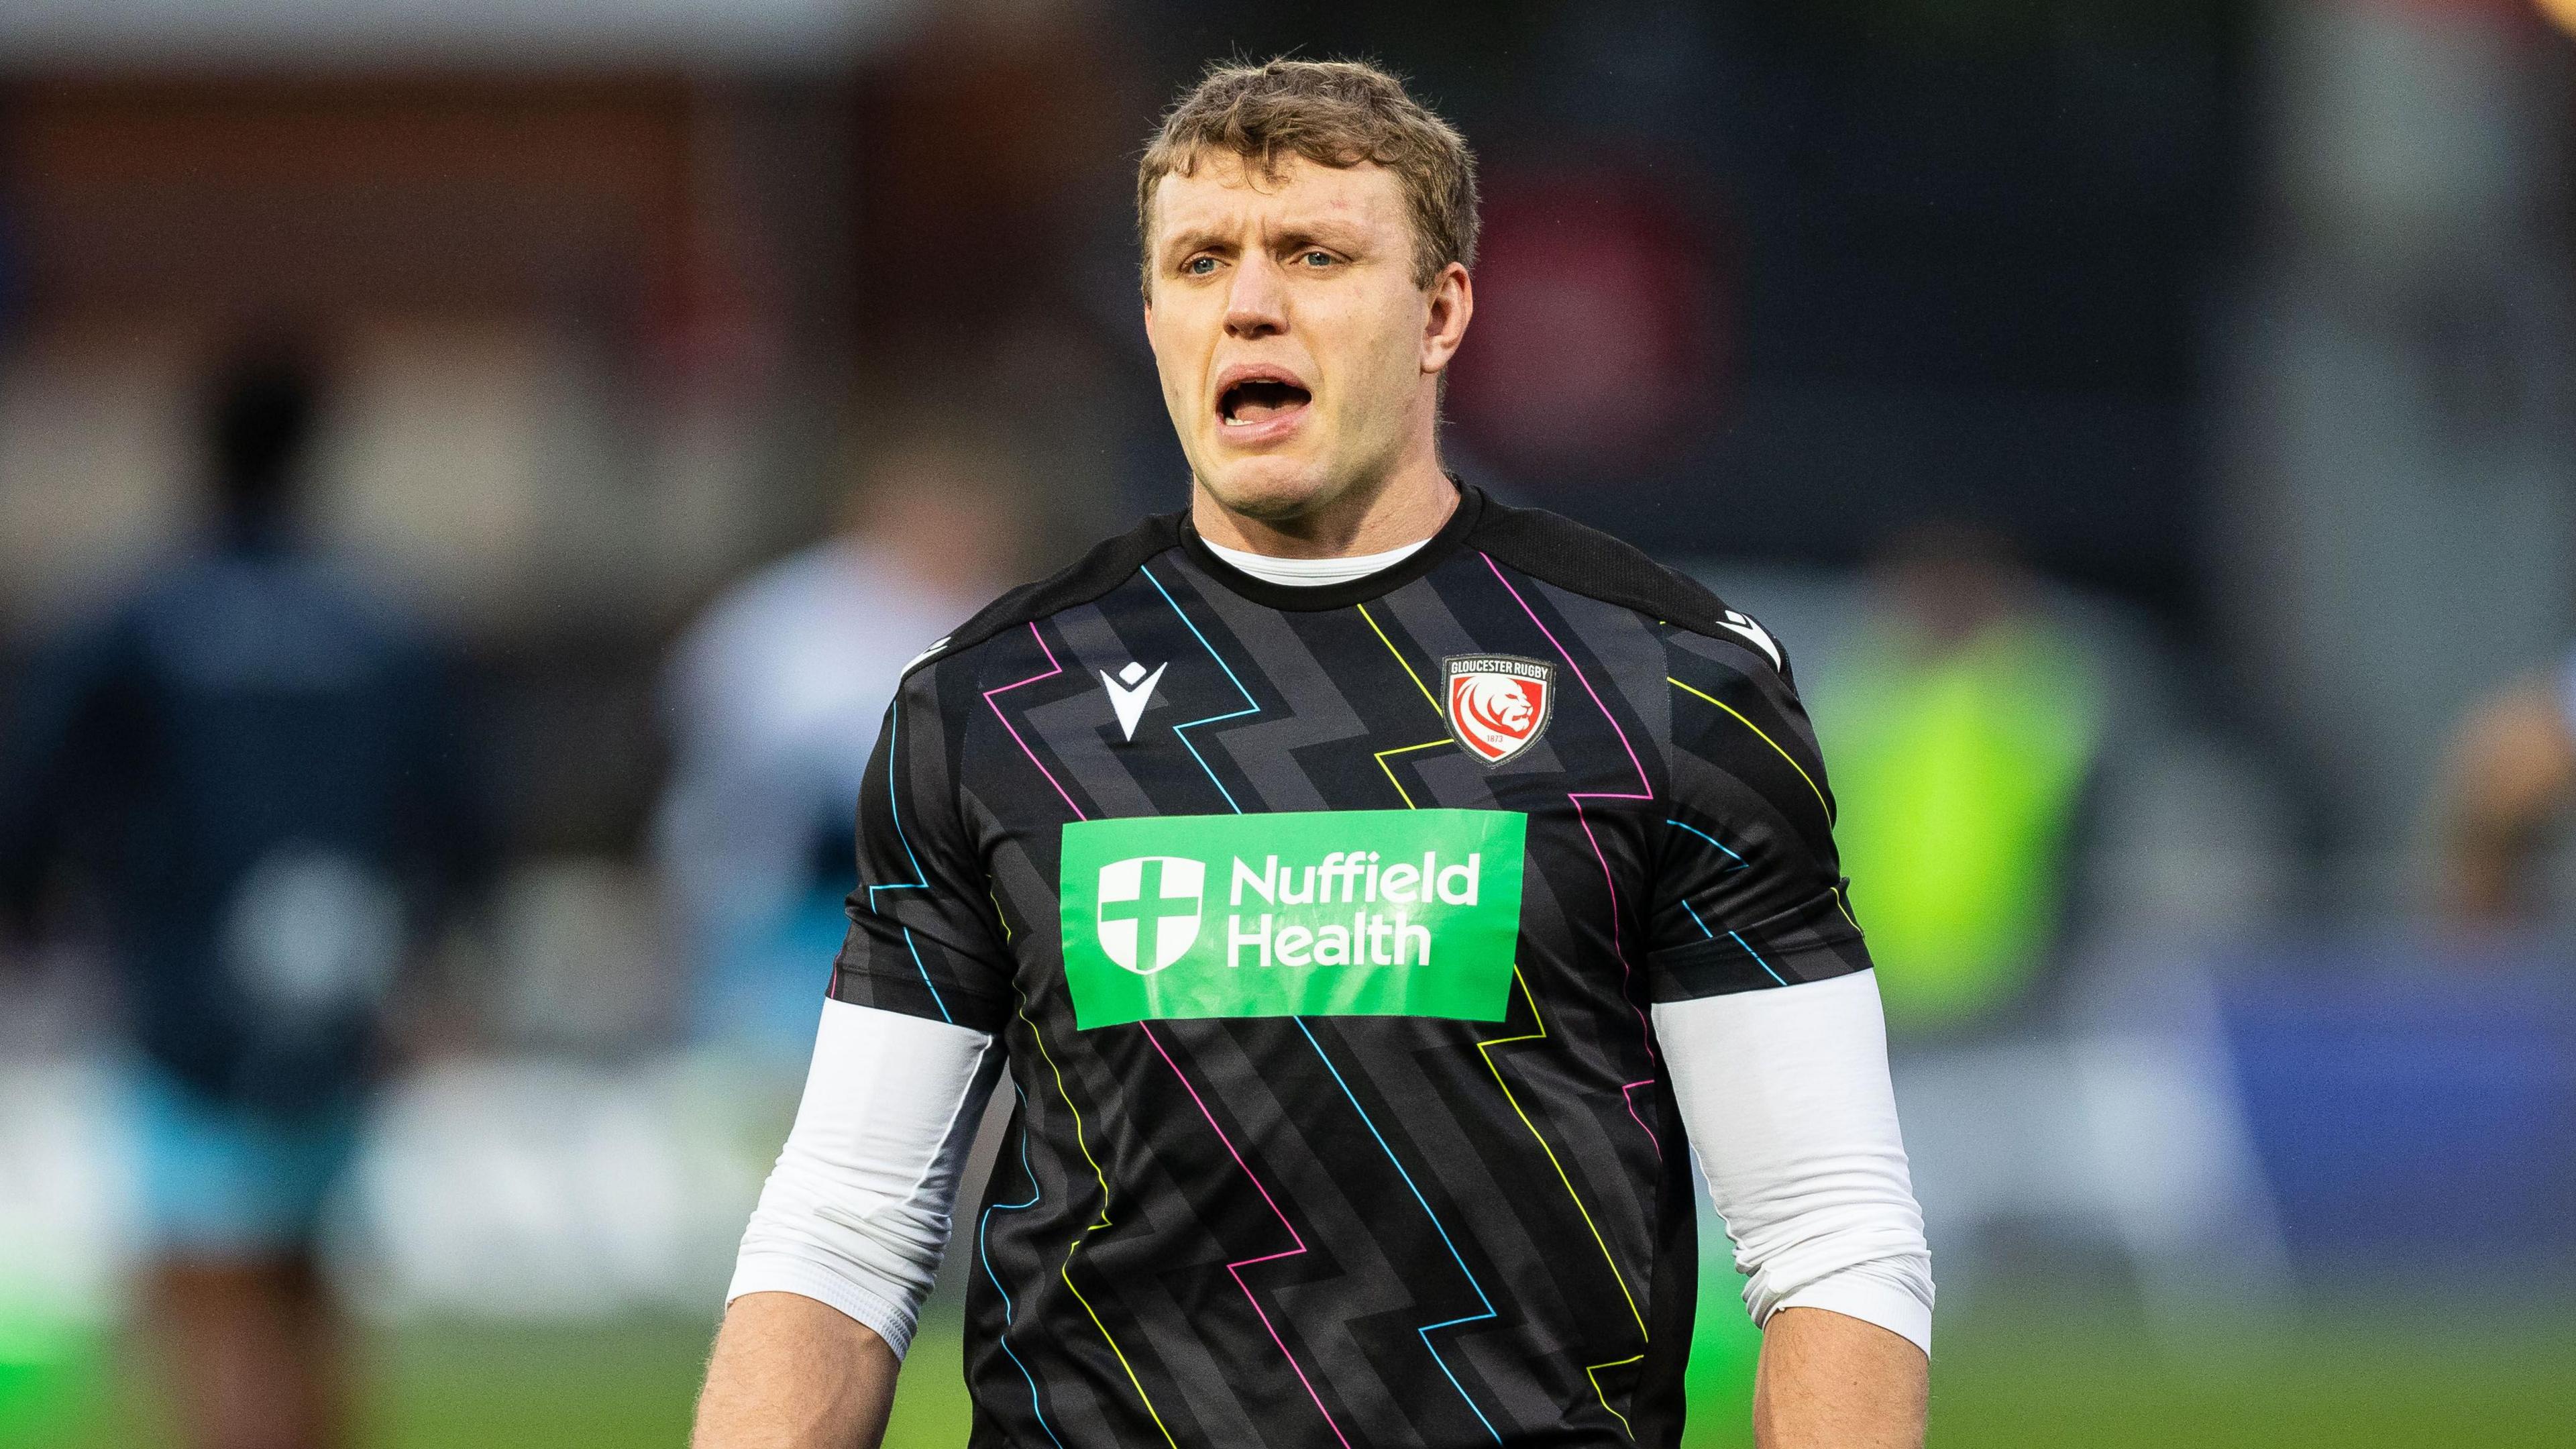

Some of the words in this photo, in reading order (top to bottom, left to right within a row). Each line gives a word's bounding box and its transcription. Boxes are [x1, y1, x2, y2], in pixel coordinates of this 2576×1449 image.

[1451, 659, 1512, 674] GLOUCESTER
[1514, 662, 1548, 680] RUGBY
[1230, 851, 1480, 906] Nuffield
[1227, 911, 1432, 967] Health
